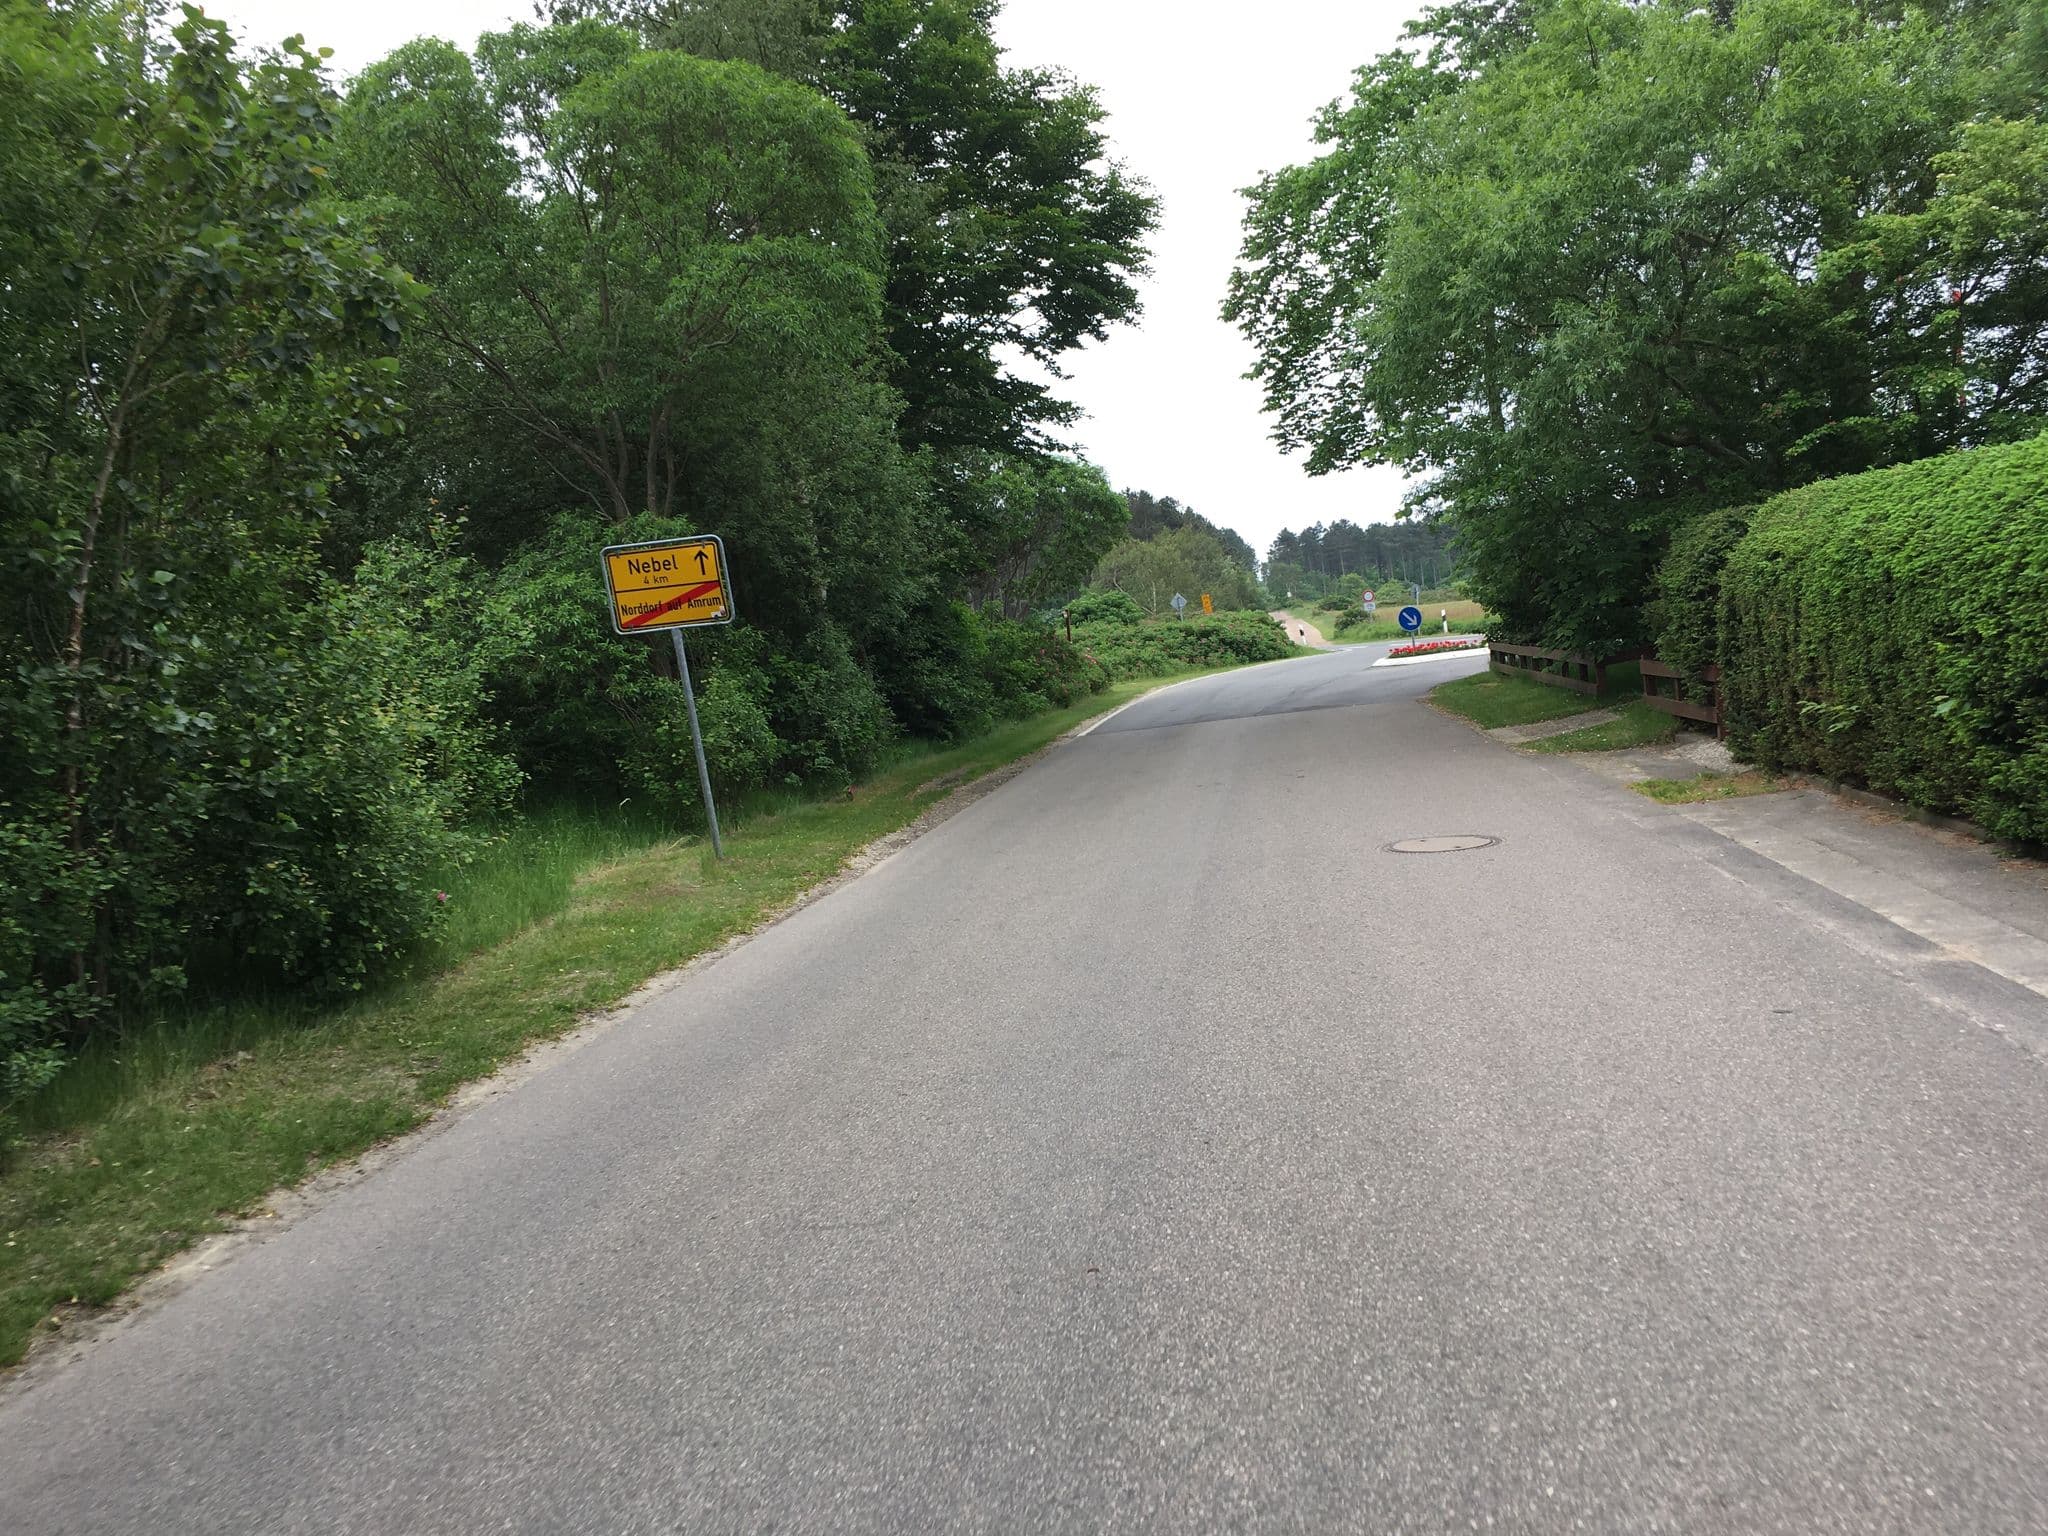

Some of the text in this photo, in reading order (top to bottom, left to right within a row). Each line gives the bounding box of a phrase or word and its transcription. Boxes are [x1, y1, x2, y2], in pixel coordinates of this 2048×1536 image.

[628, 554, 678, 575] Nebel
[643, 575, 669, 585] 4 km
[621, 596, 722, 616] Norddorf auf Amrum
